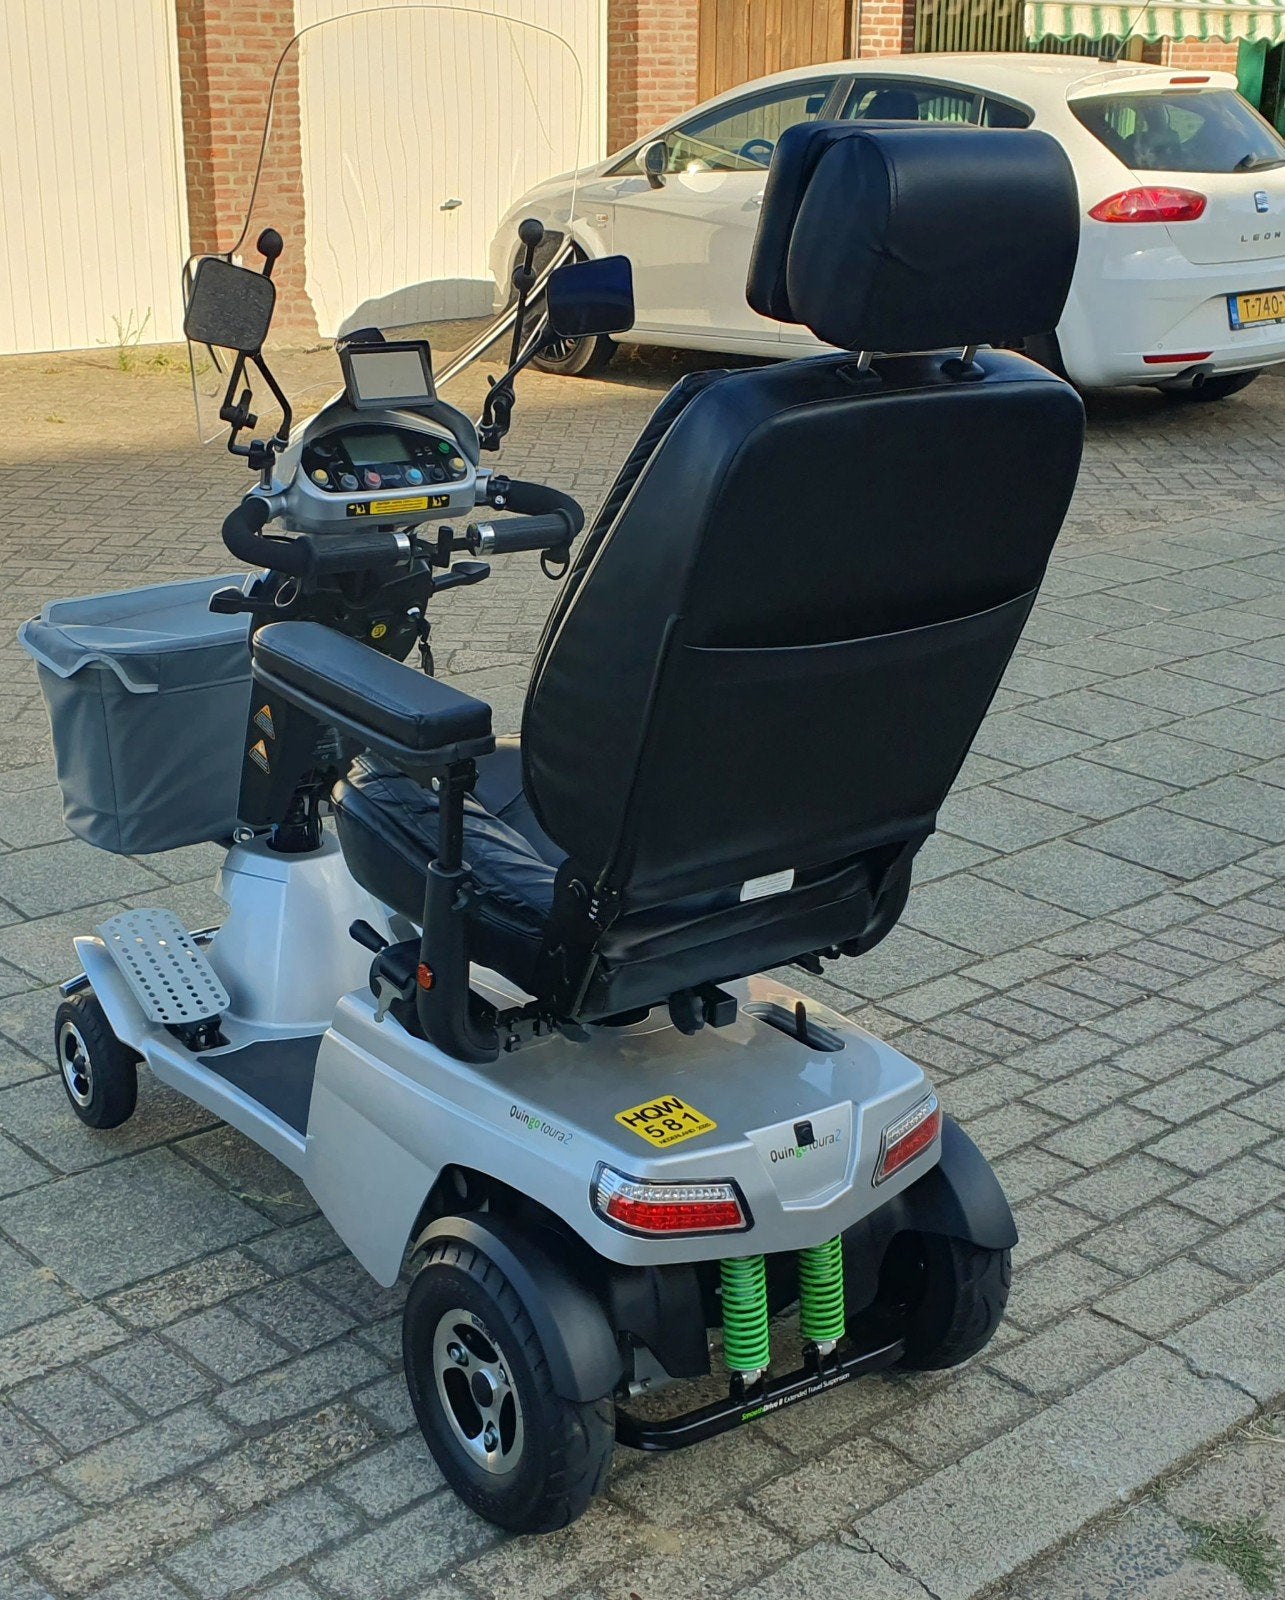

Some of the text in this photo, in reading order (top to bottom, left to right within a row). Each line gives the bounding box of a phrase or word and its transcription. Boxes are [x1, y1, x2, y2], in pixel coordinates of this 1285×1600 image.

[1241, 231, 1281, 243] LEON
[1243, 294, 1285, 319] T-740-
[509, 1104, 573, 1145] Quingo toura2
[621, 1097, 684, 1127] HQW
[643, 1112, 700, 1138] 581
